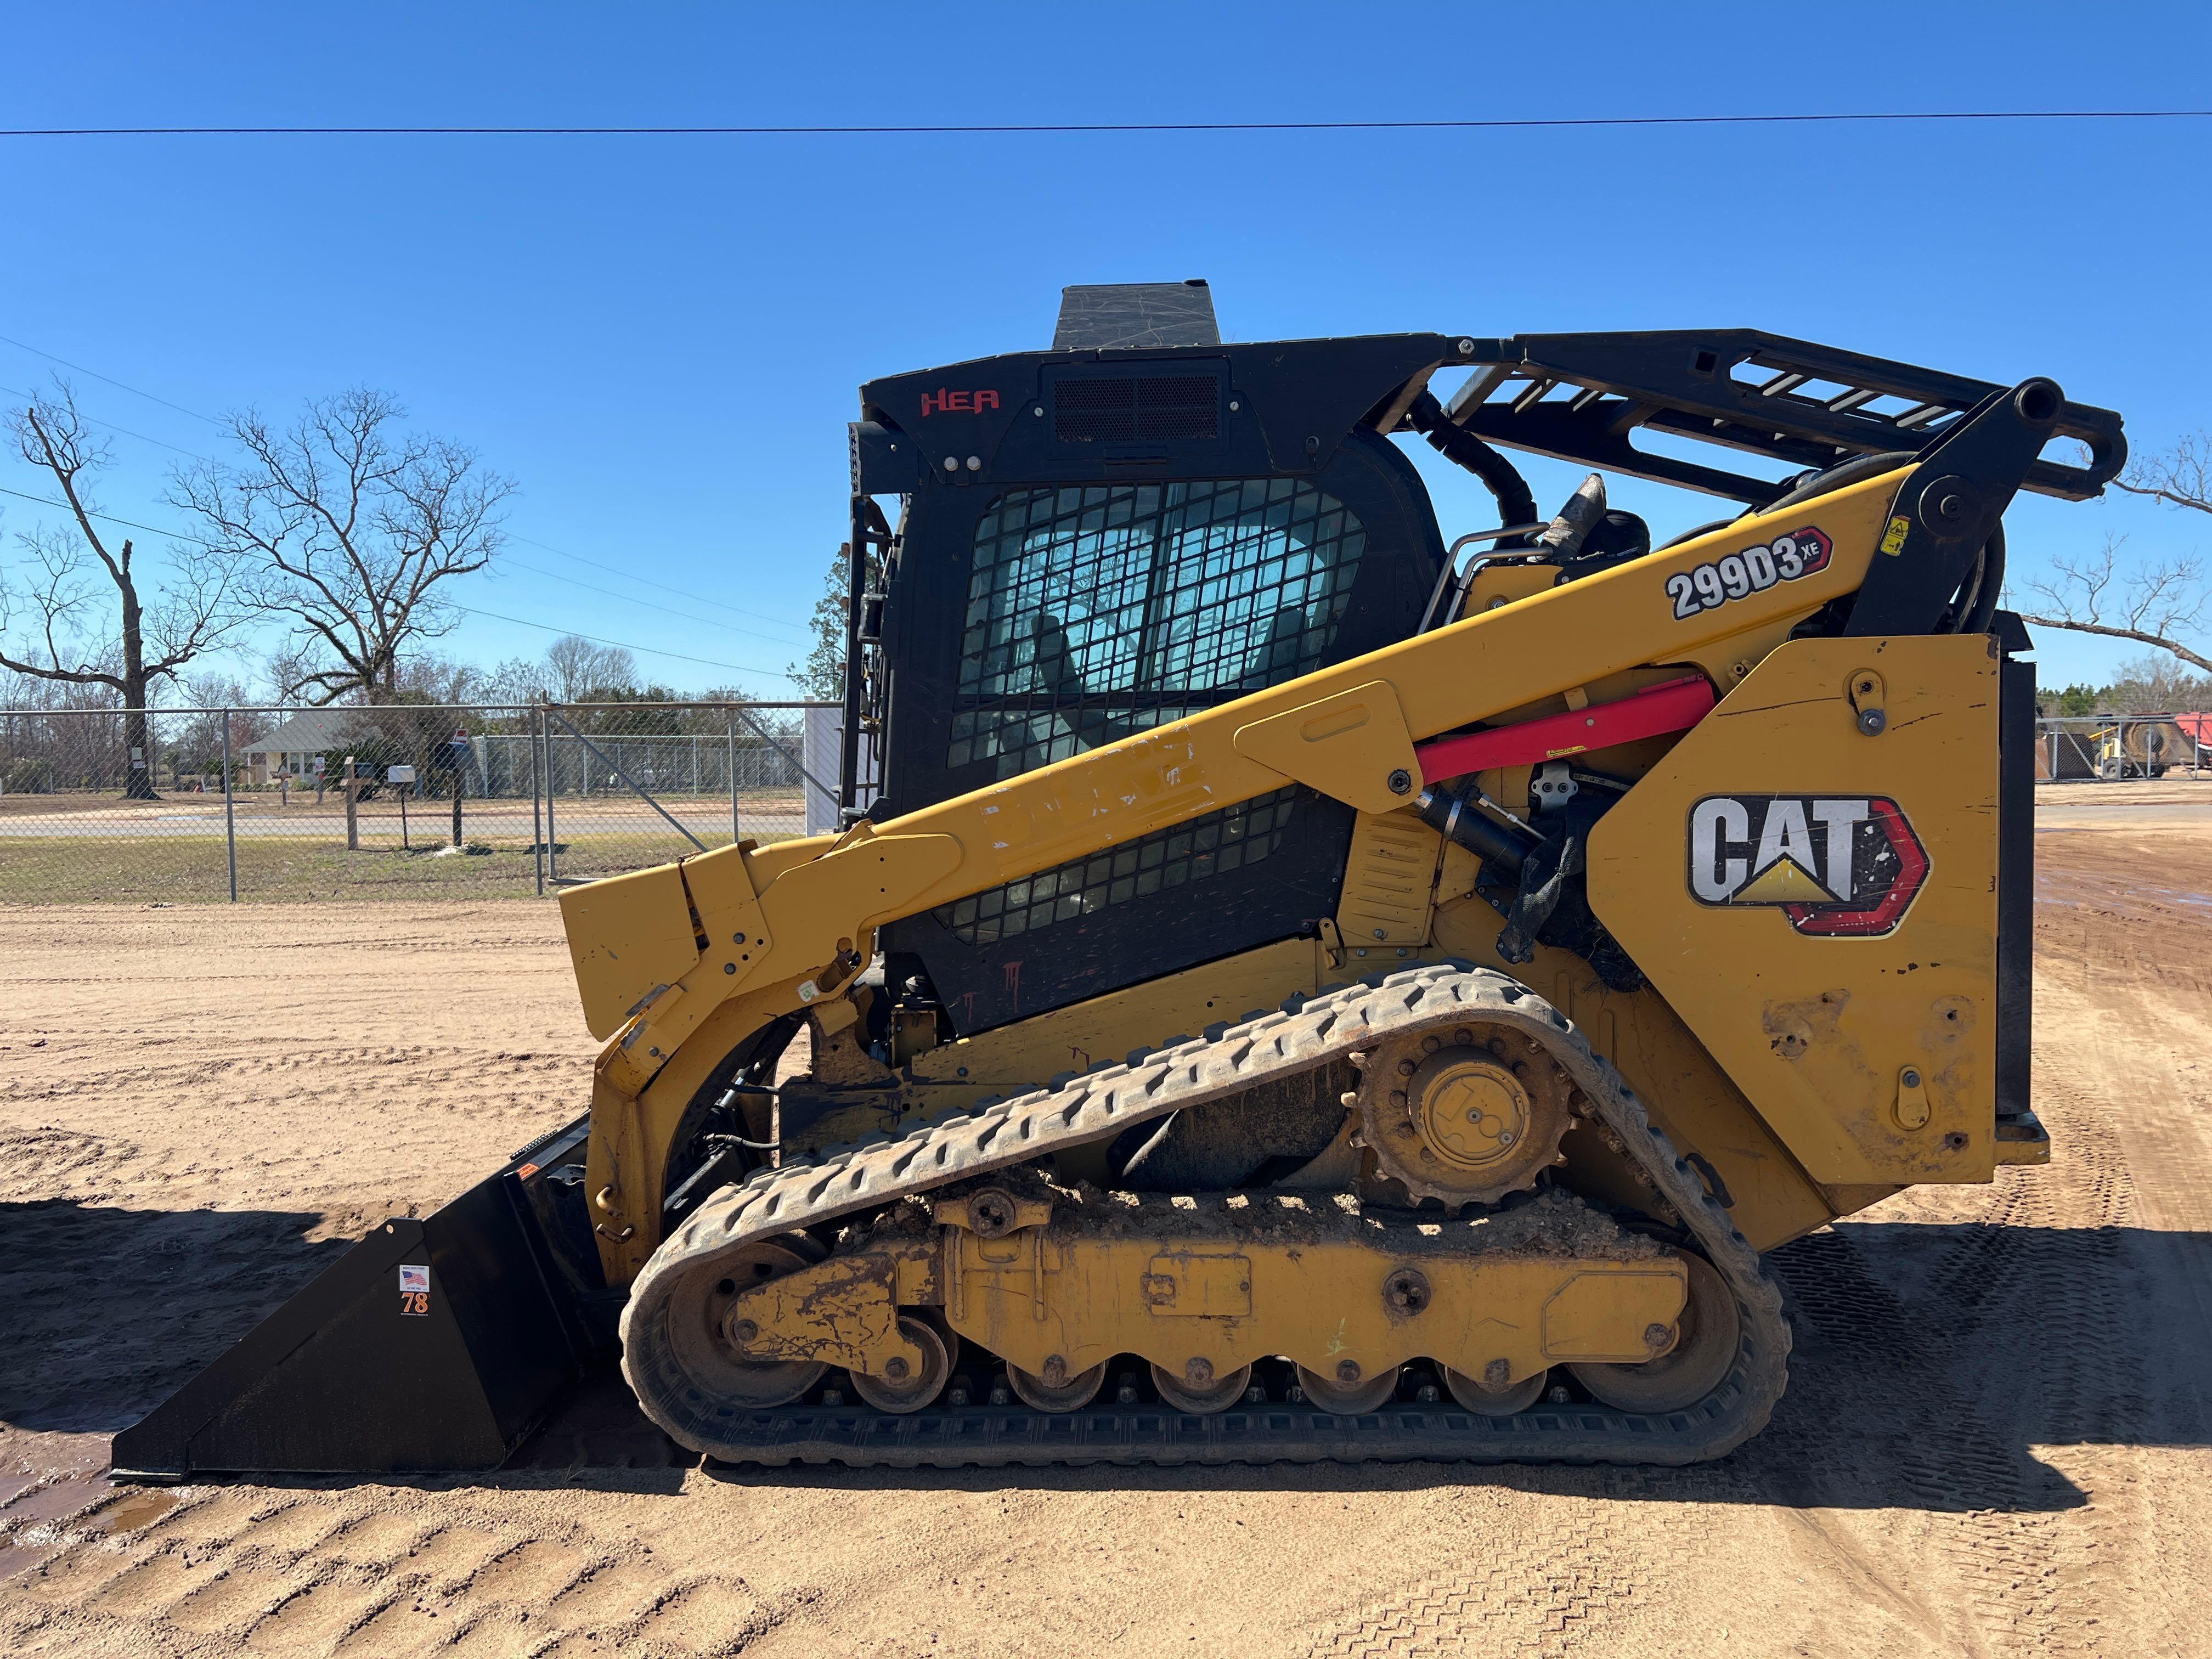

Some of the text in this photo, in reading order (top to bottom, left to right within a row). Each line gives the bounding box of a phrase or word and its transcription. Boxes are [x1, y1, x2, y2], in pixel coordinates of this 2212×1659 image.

[1668, 537, 1820, 618] 299D3 XE
[1692, 798, 1869, 901] CAT
